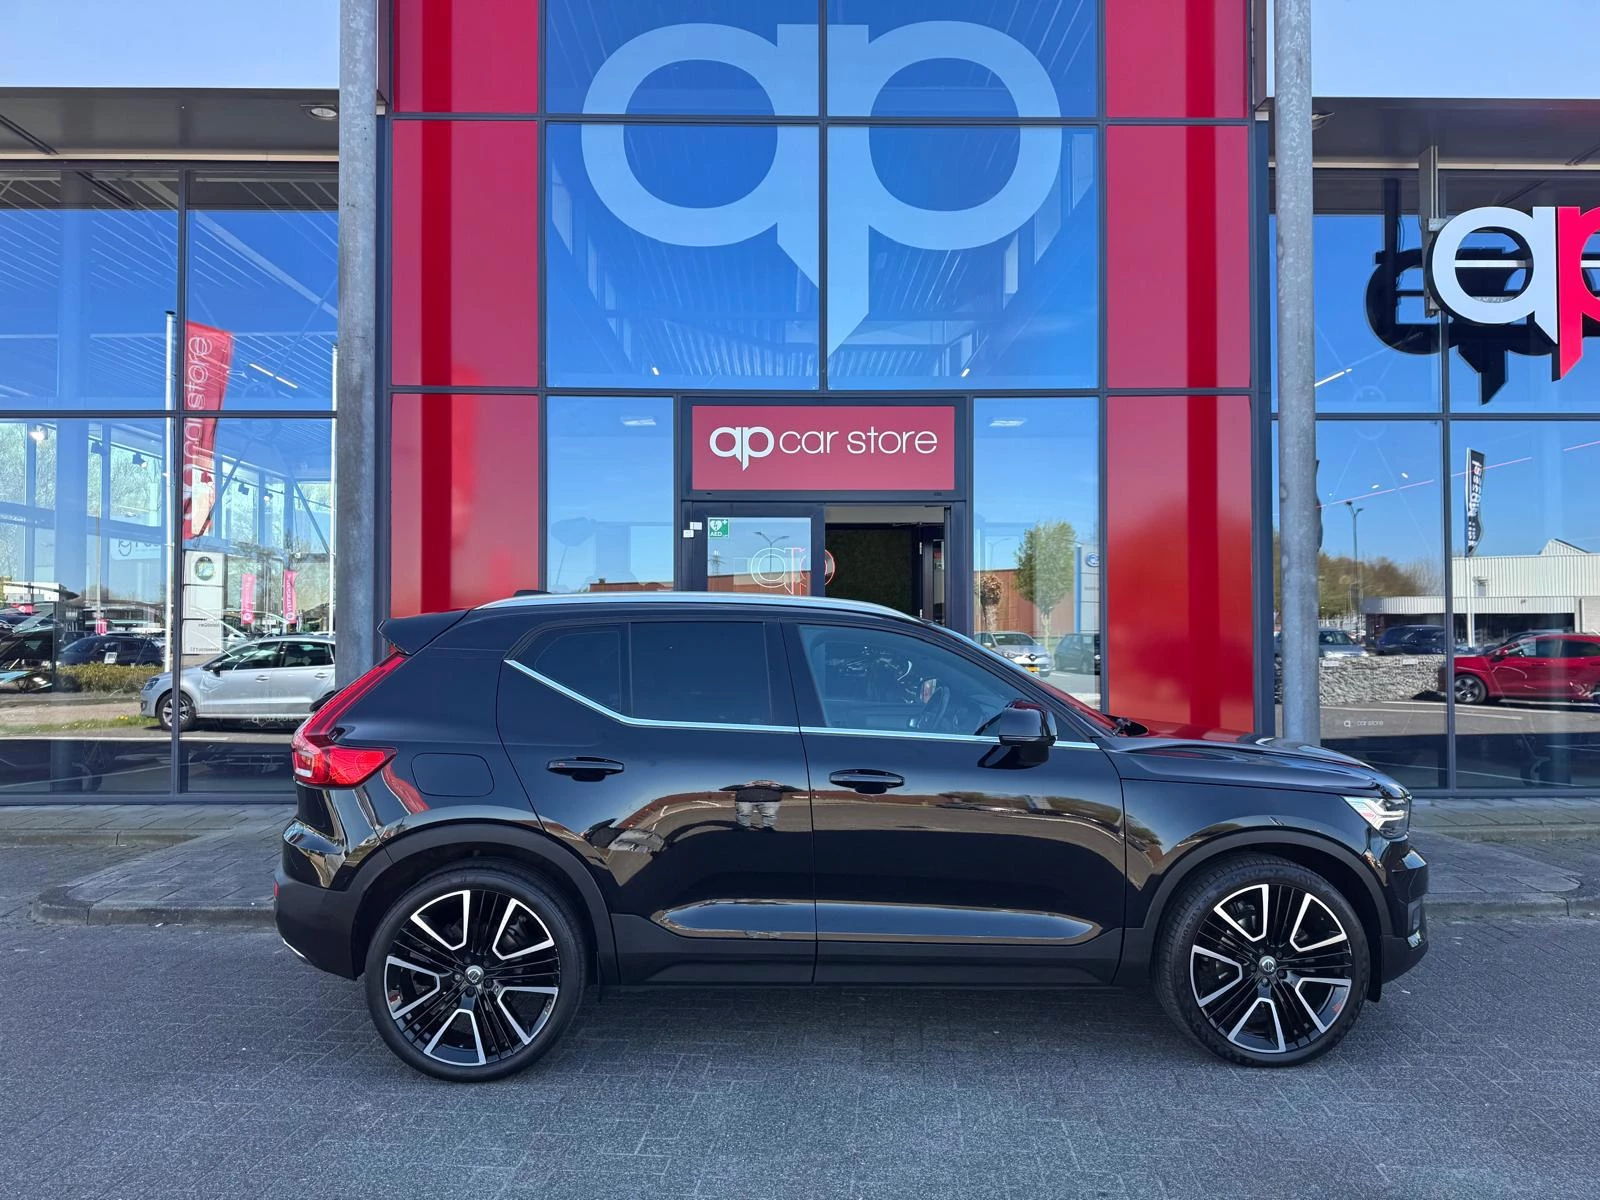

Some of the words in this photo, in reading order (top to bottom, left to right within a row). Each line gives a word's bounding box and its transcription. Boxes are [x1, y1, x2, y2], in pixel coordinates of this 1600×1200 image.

[581, 21, 1062, 358] ap
[709, 426, 775, 471] ap
[779, 431, 839, 454] car
[846, 426, 938, 454] store
